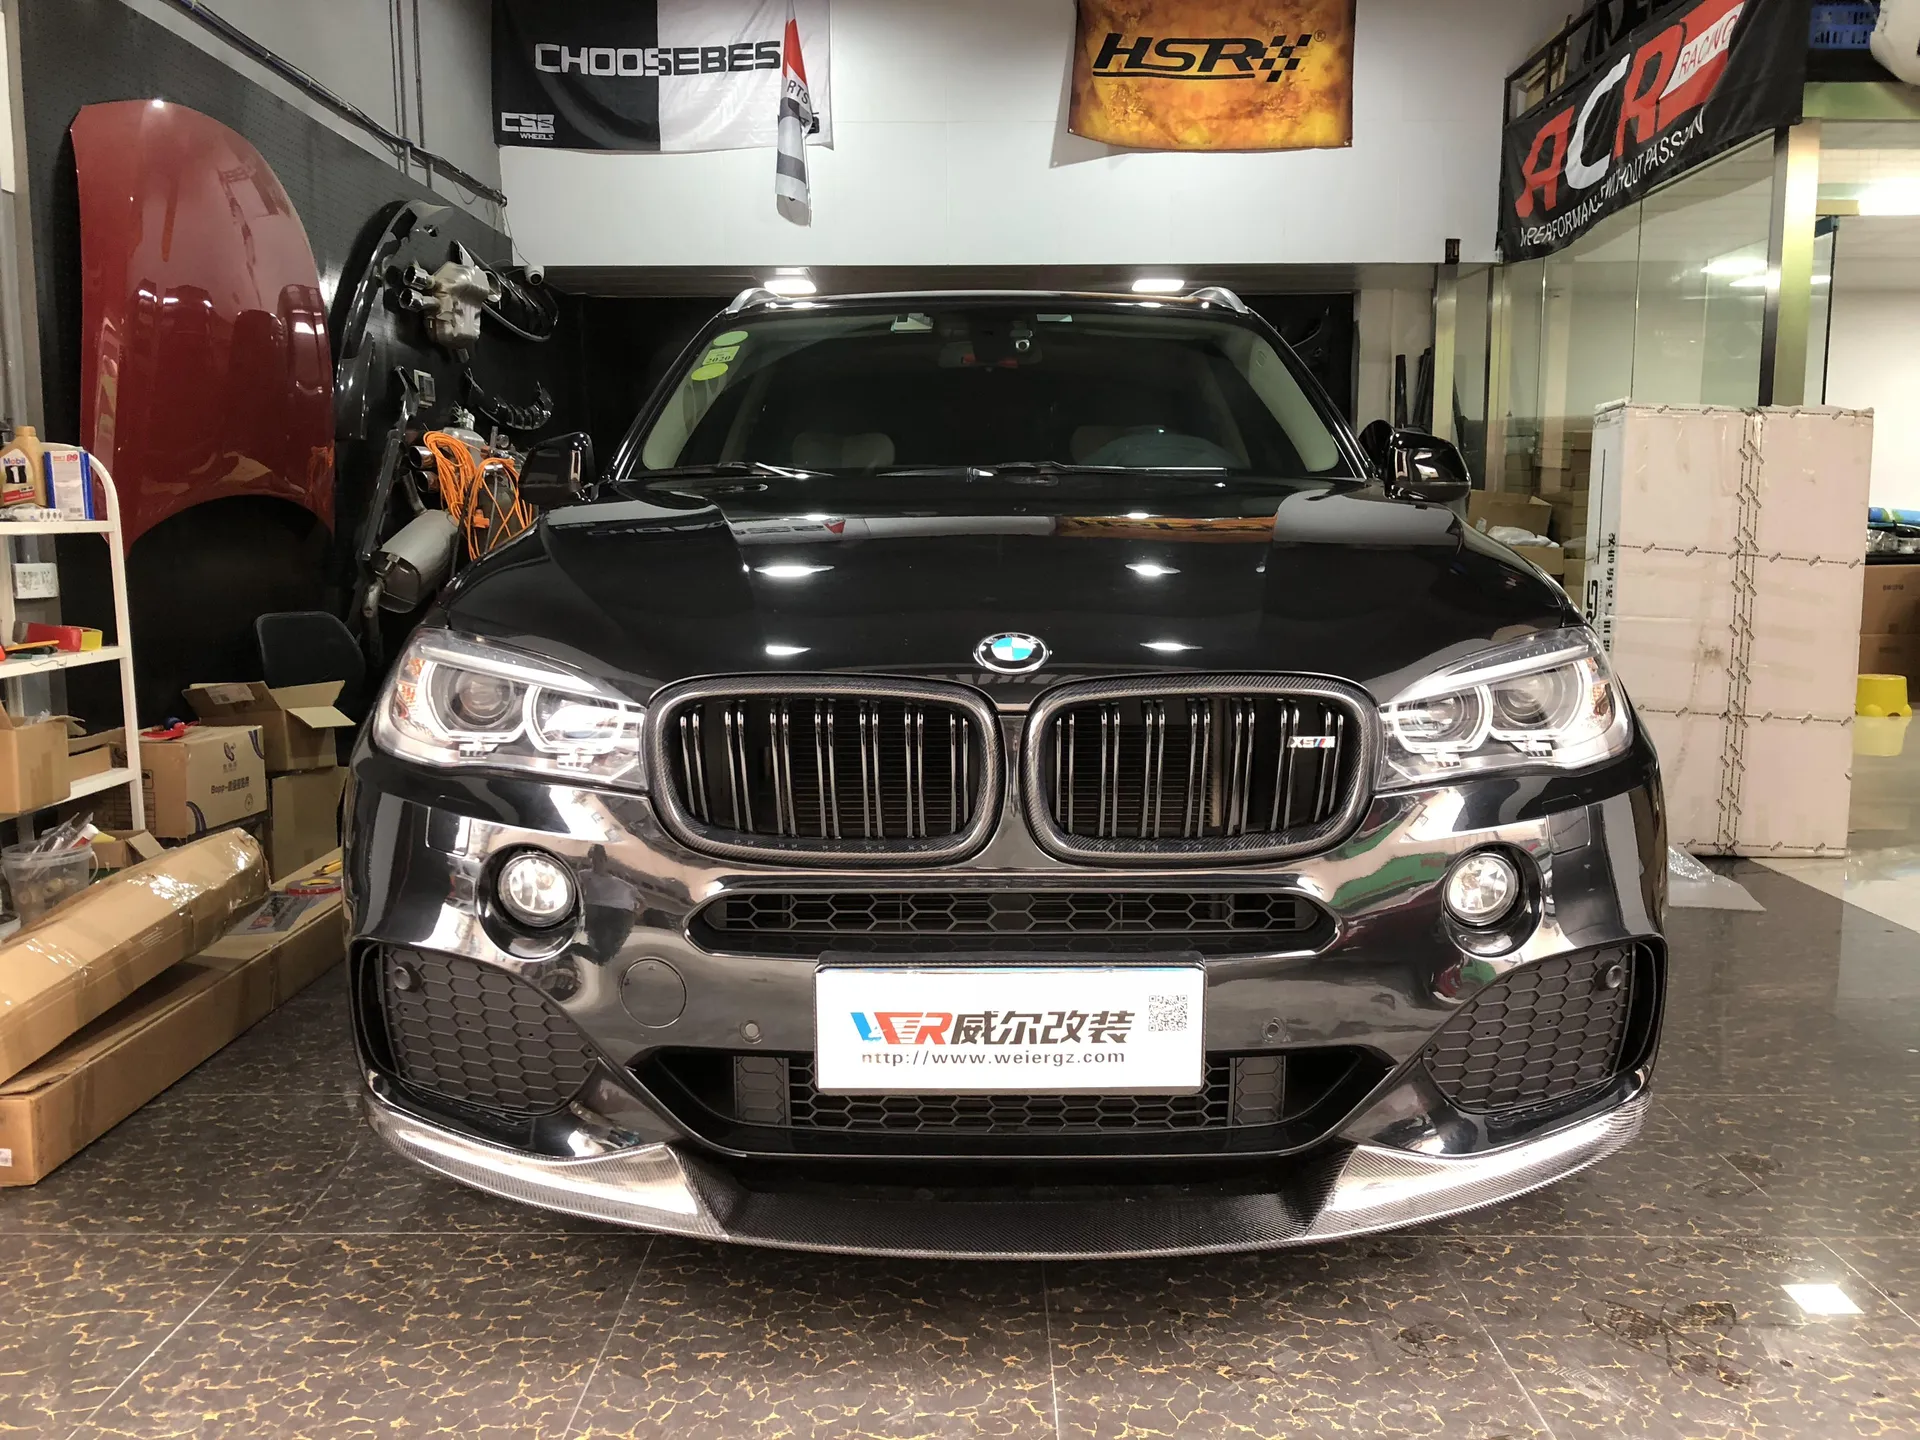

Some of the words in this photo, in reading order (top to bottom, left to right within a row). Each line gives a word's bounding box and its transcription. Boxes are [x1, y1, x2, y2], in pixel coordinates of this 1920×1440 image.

[1093, 33, 1268, 73] HSR
[519, 132, 554, 140] WHEELS
[950, 1010, 1135, 1045] 威尔改装
